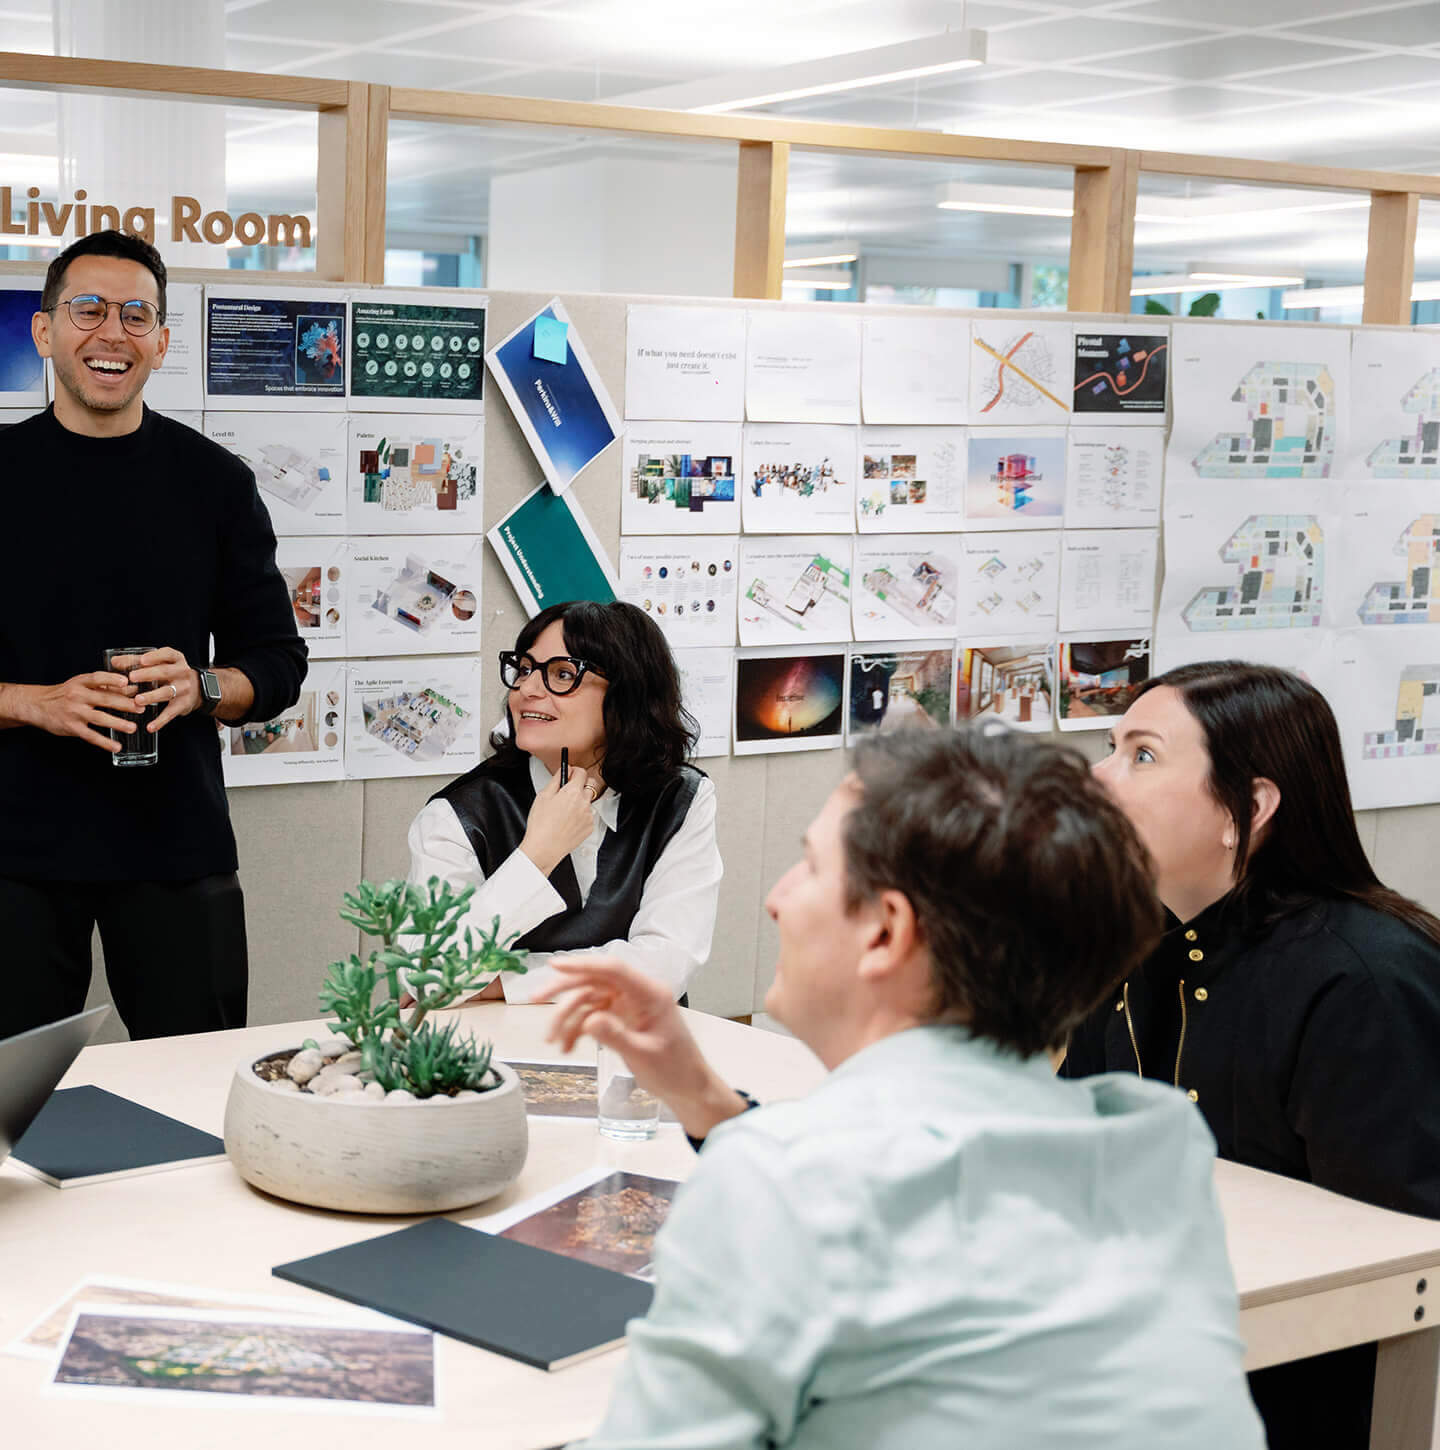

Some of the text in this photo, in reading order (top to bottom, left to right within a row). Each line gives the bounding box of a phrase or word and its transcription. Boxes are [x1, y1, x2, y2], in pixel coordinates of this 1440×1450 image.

[0, 185, 156, 245] Living
[171, 195, 312, 249] Room
[644, 349, 663, 357] what
[664, 351, 678, 360] you
[678, 351, 696, 359] need
[680, 362, 701, 370] create
[264, 384, 344, 394] Spaces that embrace innovation
[533, 378, 563, 428] Perkins&Will
[503, 525, 544, 600] Project Understanding
